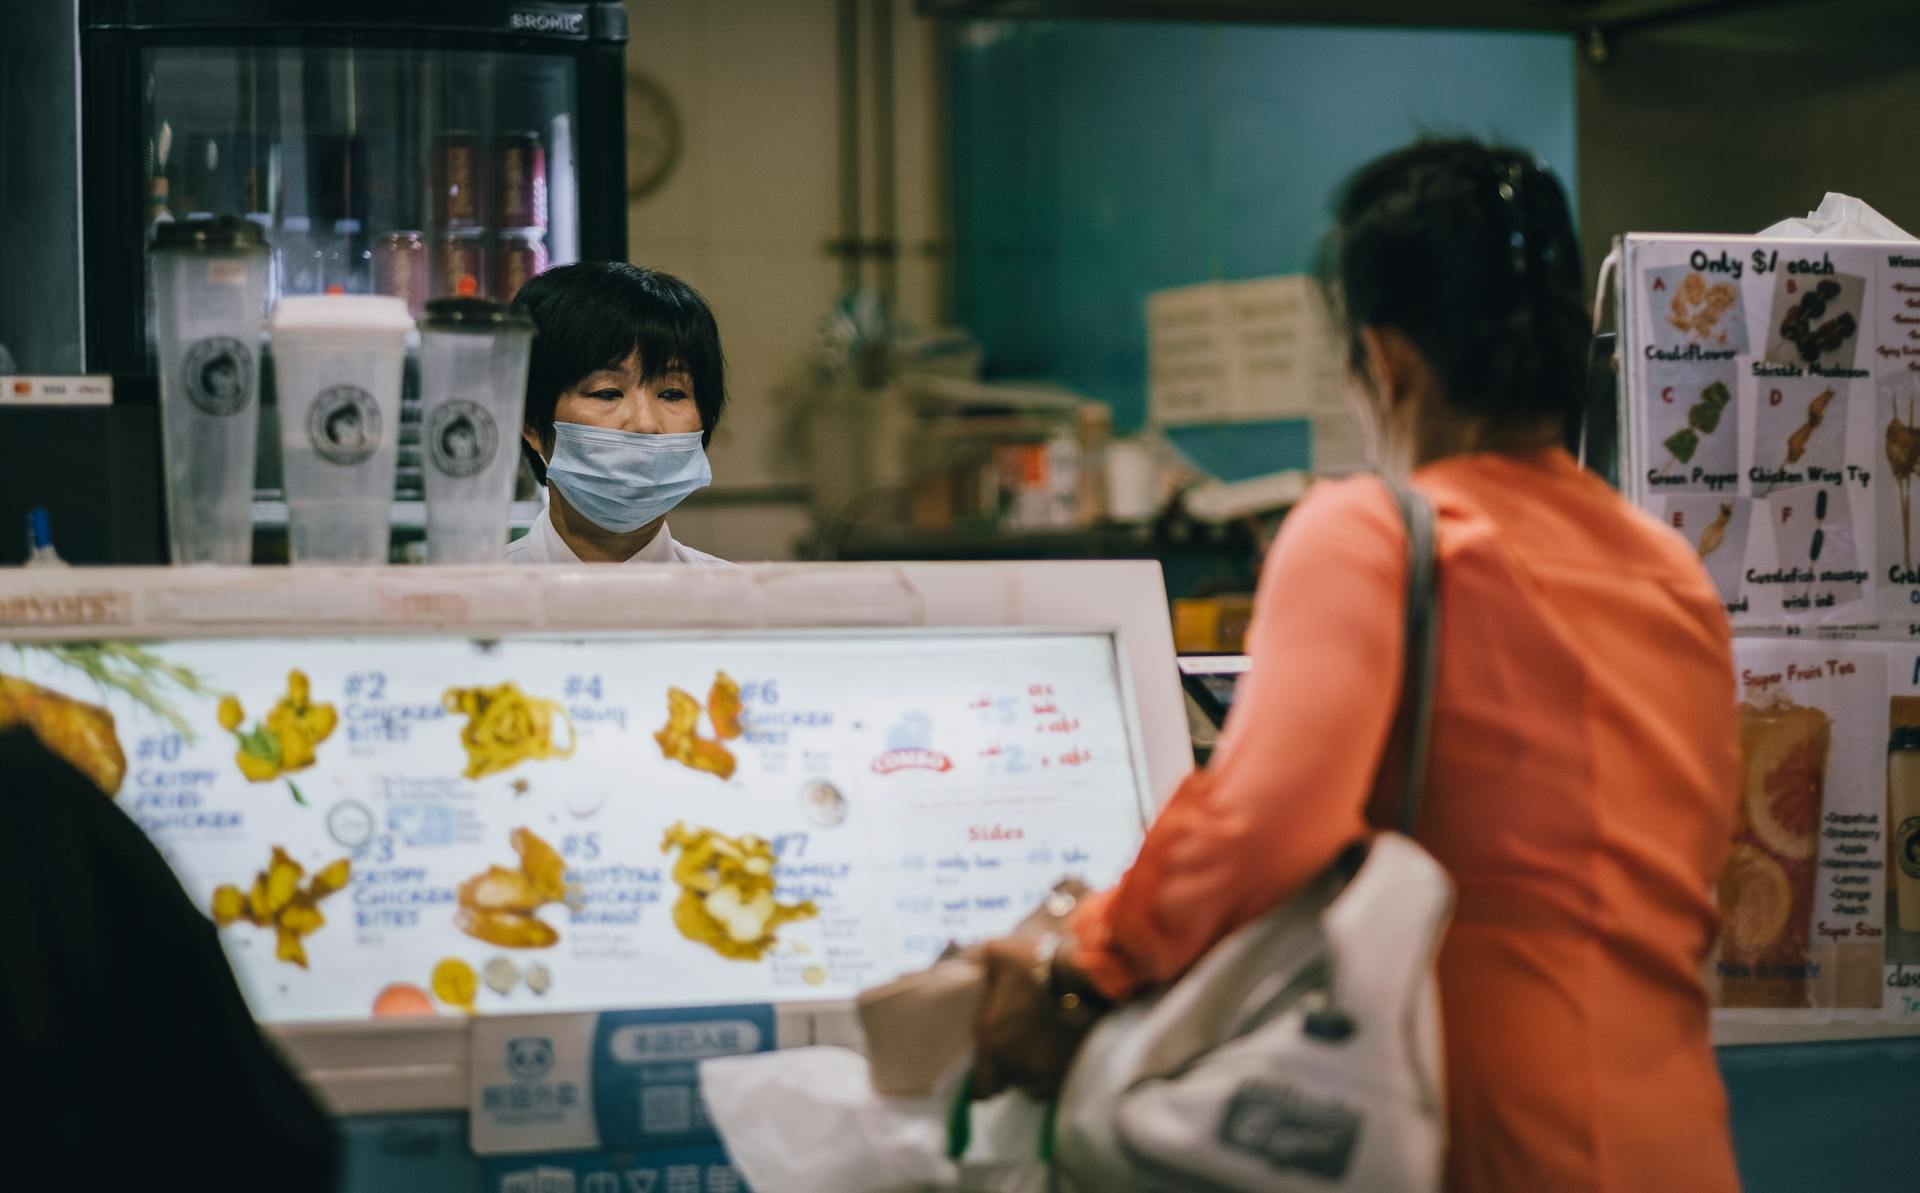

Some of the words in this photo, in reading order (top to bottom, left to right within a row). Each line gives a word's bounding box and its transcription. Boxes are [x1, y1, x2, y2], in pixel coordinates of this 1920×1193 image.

[510, 13, 584, 33] BROMIC
[1690, 250, 1742, 279] Only
[1787, 252, 1835, 275] each
[1653, 276, 1666, 292] A
[1786, 279, 1798, 294] B
[1661, 386, 1674, 403] C
[1769, 389, 1783, 406] D
[1647, 468, 1688, 486] Green
[1692, 467, 1738, 491] Pepper
[1749, 466, 1802, 484] Chicken
[1808, 466, 1843, 485] Wing
[1847, 465, 1871, 488] Tip
[1672, 511, 1684, 528] E
[1781, 506, 1793, 523] F
[345, 671, 386, 699] #2
[565, 673, 603, 700] #4
[1742, 669, 1783, 691] Super
[1788, 663, 1822, 681] Fruit
[1826, 659, 1856, 676] Tea
[740, 678, 779, 704] #6
[772, 832, 809, 857] #7
[968, 825, 1024, 842] Sides
[351, 835, 394, 862] #3
[562, 831, 601, 860] #5
[1818, 921, 1852, 941] Super
[1856, 921, 1883, 937] Size
